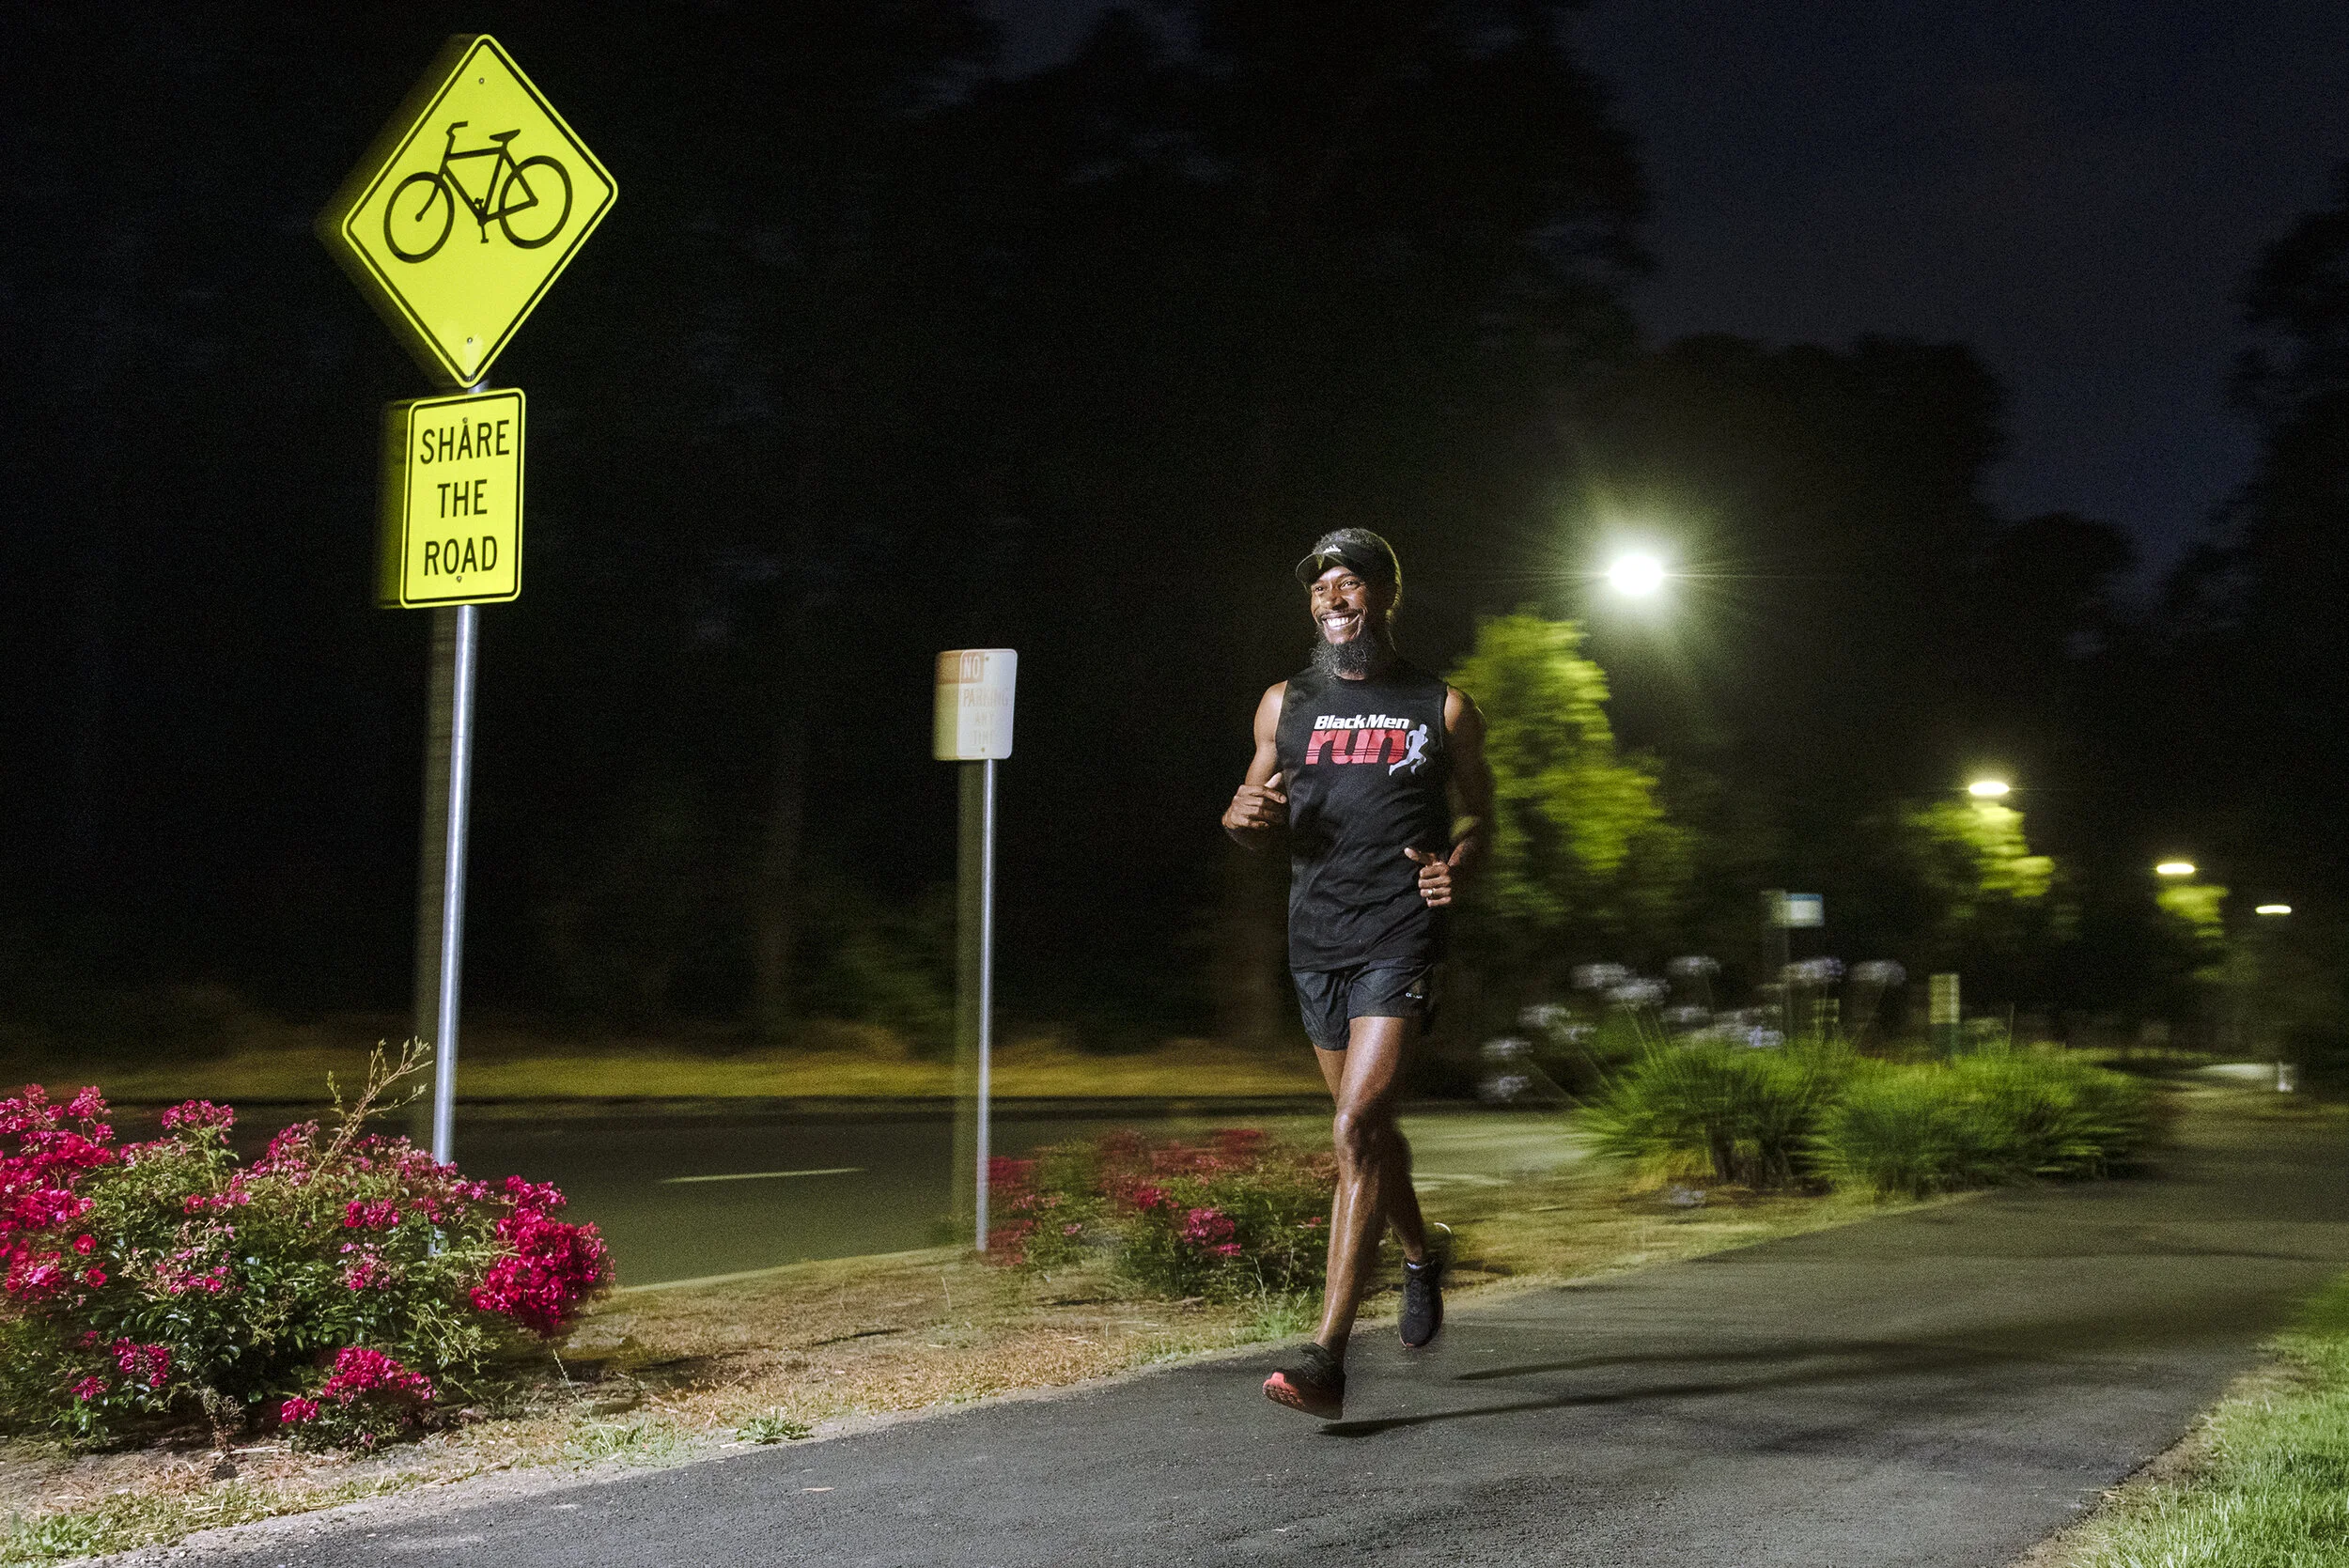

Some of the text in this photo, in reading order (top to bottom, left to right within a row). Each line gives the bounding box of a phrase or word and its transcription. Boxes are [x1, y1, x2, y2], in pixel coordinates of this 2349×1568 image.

[420, 420, 510, 465] SHARE
[437, 479, 488, 518] THE
[424, 536, 497, 576] ROAD
[963, 656, 981, 678] NO
[1305, 729, 1406, 765] run
